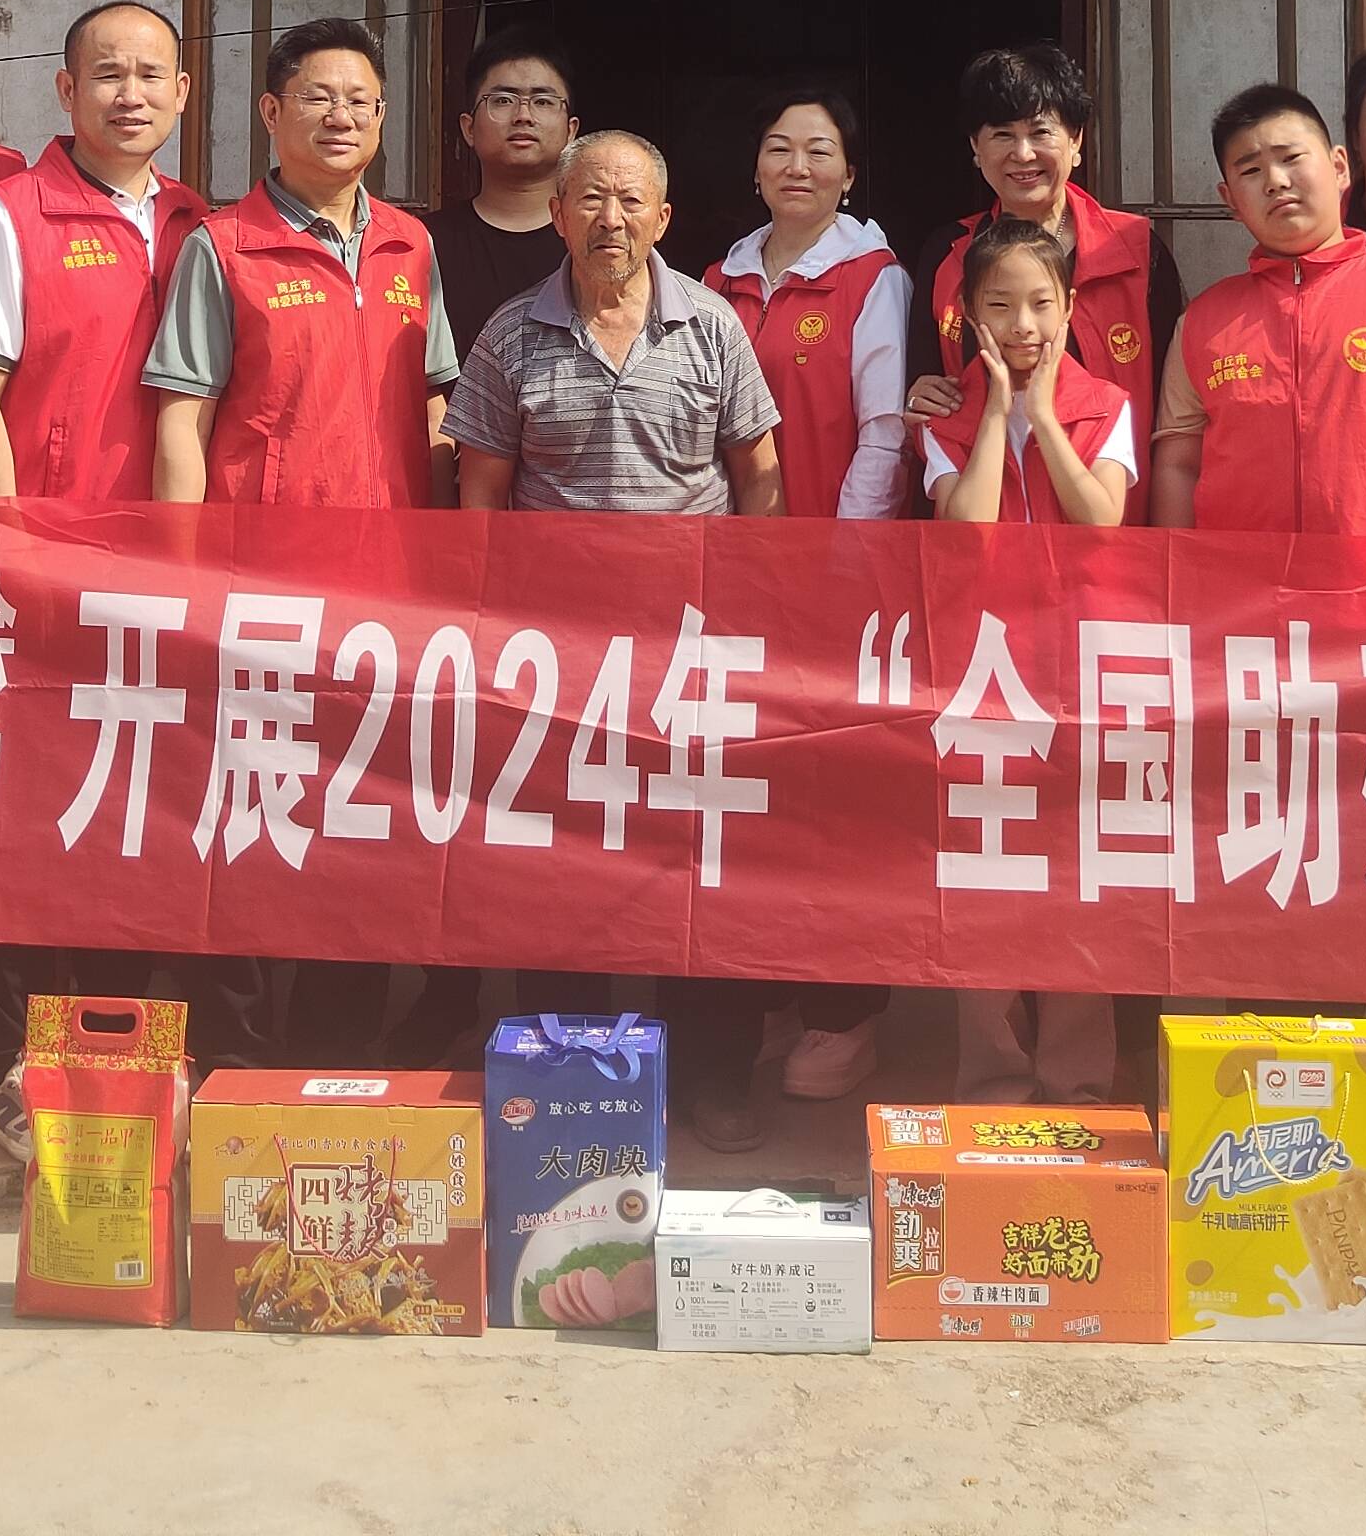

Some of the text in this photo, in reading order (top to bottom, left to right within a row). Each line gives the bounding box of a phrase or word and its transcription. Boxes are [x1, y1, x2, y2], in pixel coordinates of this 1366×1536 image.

[68, 238, 103, 254] 商丘市
[62, 251, 118, 270] 博爱联合会
[275, 279, 312, 295] 商丘市
[266, 291, 327, 310] 博爱联合会
[1211, 352, 1249, 372] 商丘市
[548, 1101, 593, 1116] 放心吃
[599, 1099, 644, 1114] 吃放心
[448, 1132, 467, 1207] 百姓食堂
[536, 1144, 648, 1181] 大肉块
[1238, 1203, 1288, 1212] MILK FLAVOR
[1201, 1211, 1291, 1232] 牛乳味高钙饼干
[893, 1209, 923, 1271] 劲爽
[1002, 1216, 1092, 1250] 吉祥龙运
[924, 1227, 940, 1272] 拉面
[730, 1262, 816, 1277] 好牛奶养成记
[1002, 1244, 1101, 1282] 好面带劲
[972, 1285, 1041, 1303] 香辣牛肉面
